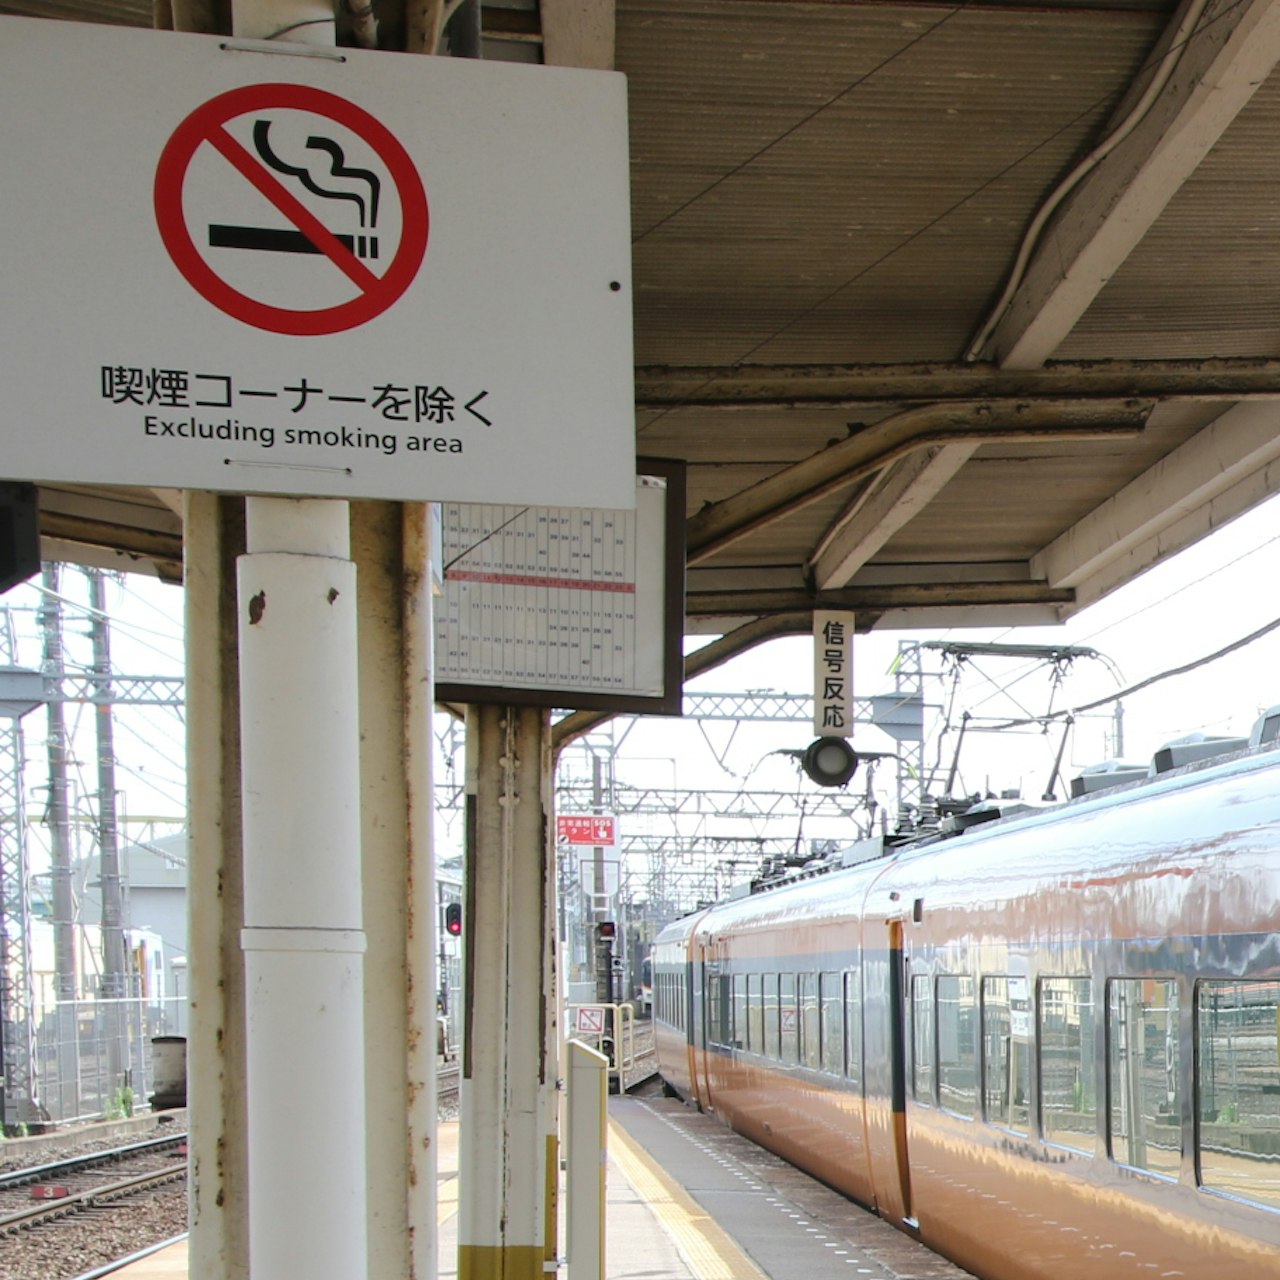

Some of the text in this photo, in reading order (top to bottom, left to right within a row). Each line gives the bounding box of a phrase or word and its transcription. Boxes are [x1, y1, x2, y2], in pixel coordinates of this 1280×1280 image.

[101, 366, 493, 428] 喫煙コーナーを除く
[144, 415, 463, 455] Excluding smoking area
[822, 619, 846, 729] 信号反応
[43, 1187, 54, 1199] 3
